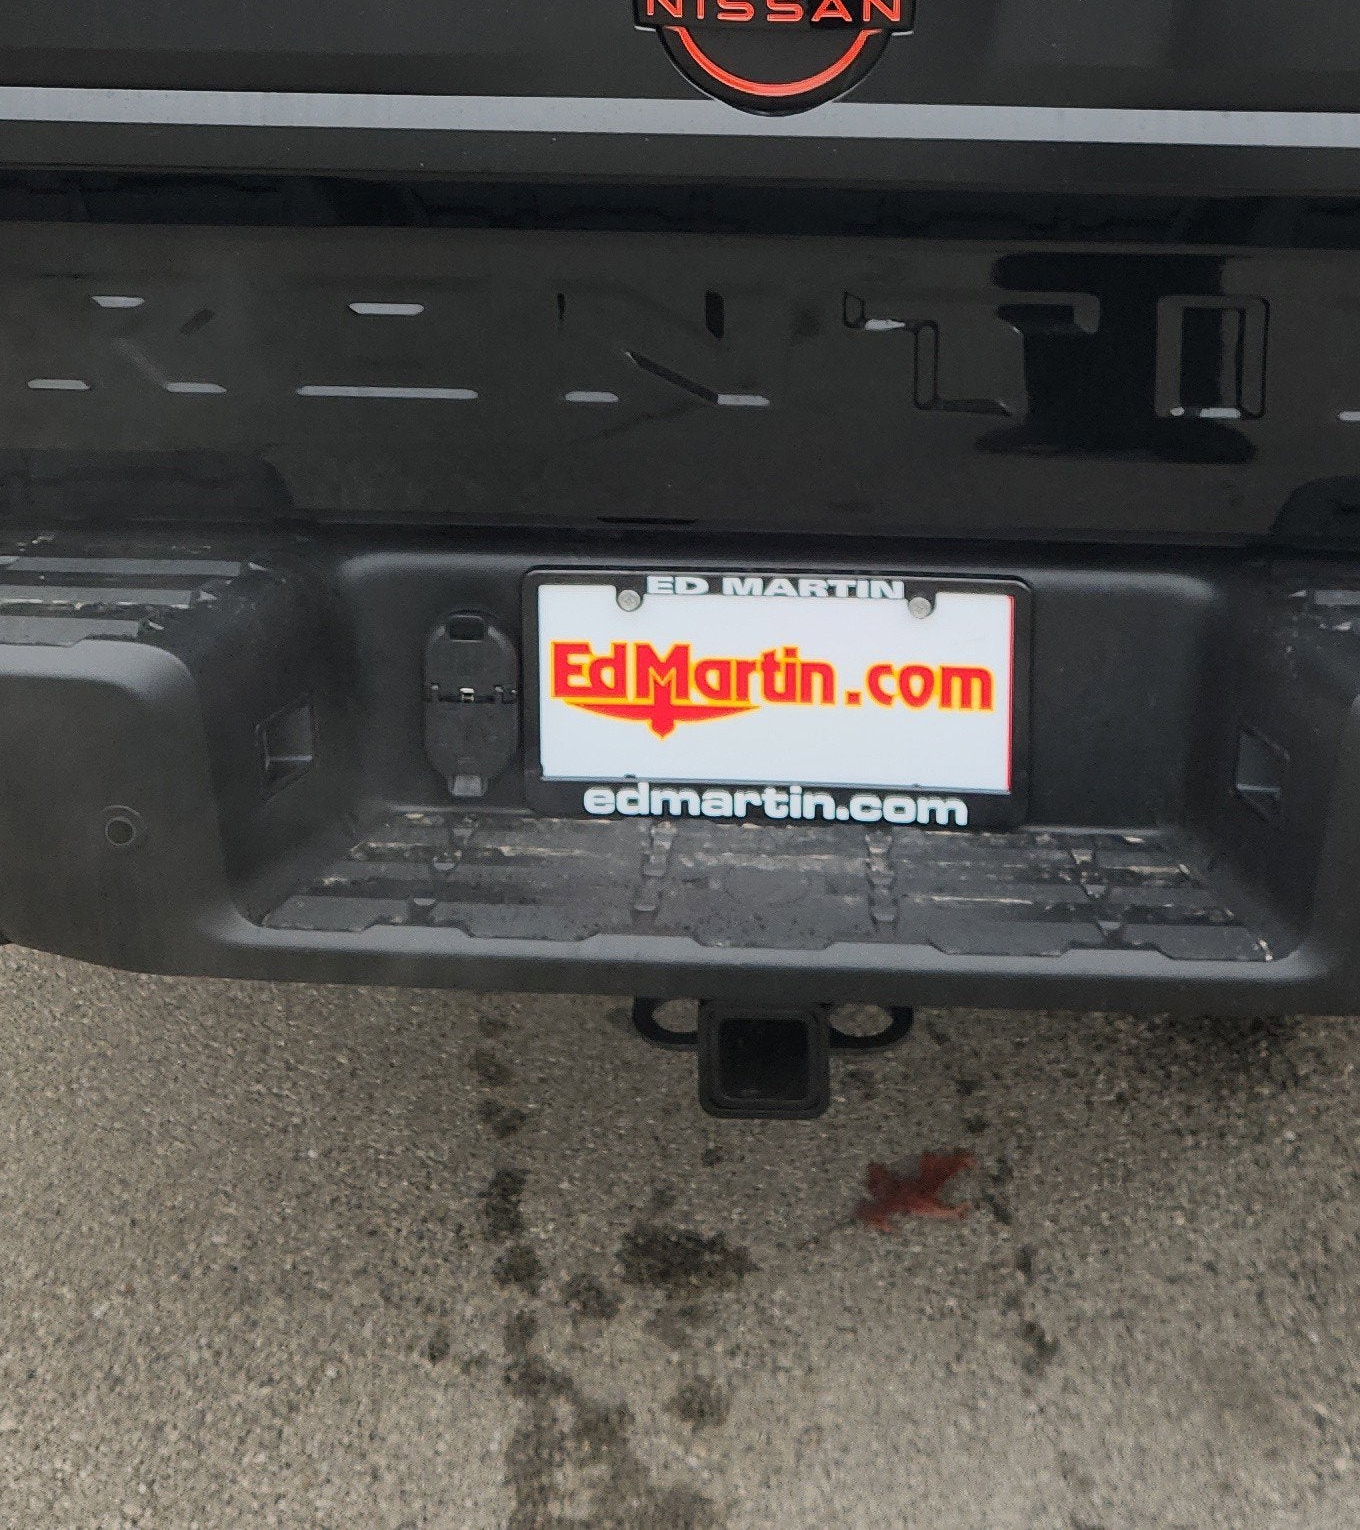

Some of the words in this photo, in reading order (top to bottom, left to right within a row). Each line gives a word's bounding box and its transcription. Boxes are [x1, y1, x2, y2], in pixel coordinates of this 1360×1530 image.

[646, 575, 710, 595] ED
[722, 576, 906, 600] MARTIN
[583, 782, 968, 825] edmartin.com
